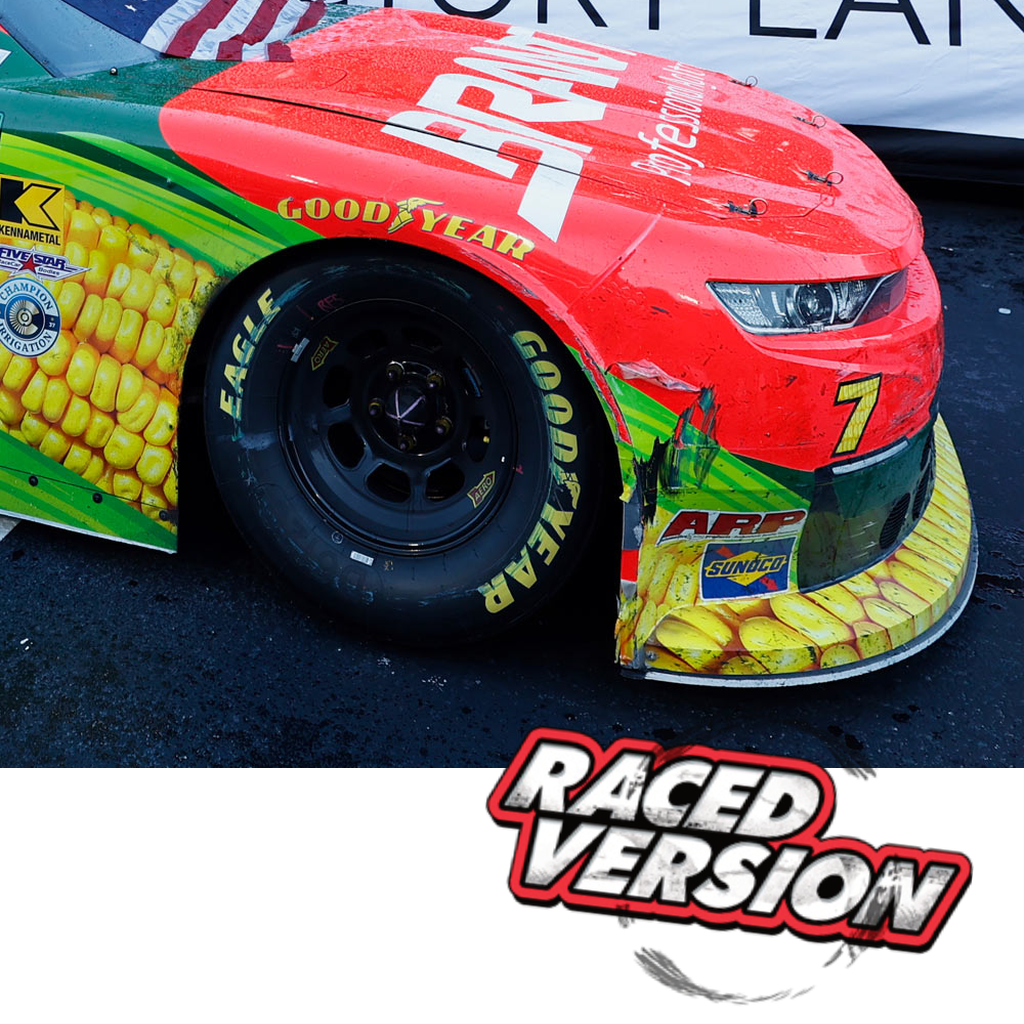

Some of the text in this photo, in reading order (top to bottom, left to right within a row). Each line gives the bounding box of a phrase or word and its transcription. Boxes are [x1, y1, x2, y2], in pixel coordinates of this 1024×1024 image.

[33, 253, 66, 268] STAR
[0, 282, 53, 311] CHAMPION
[220, 288, 281, 421] EAGLE
[831, 373, 882, 458] 7
[475, 477, 492, 501] AERO
[656, 510, 805, 547] ARP
[705, 554, 787, 577] SUNOCO
